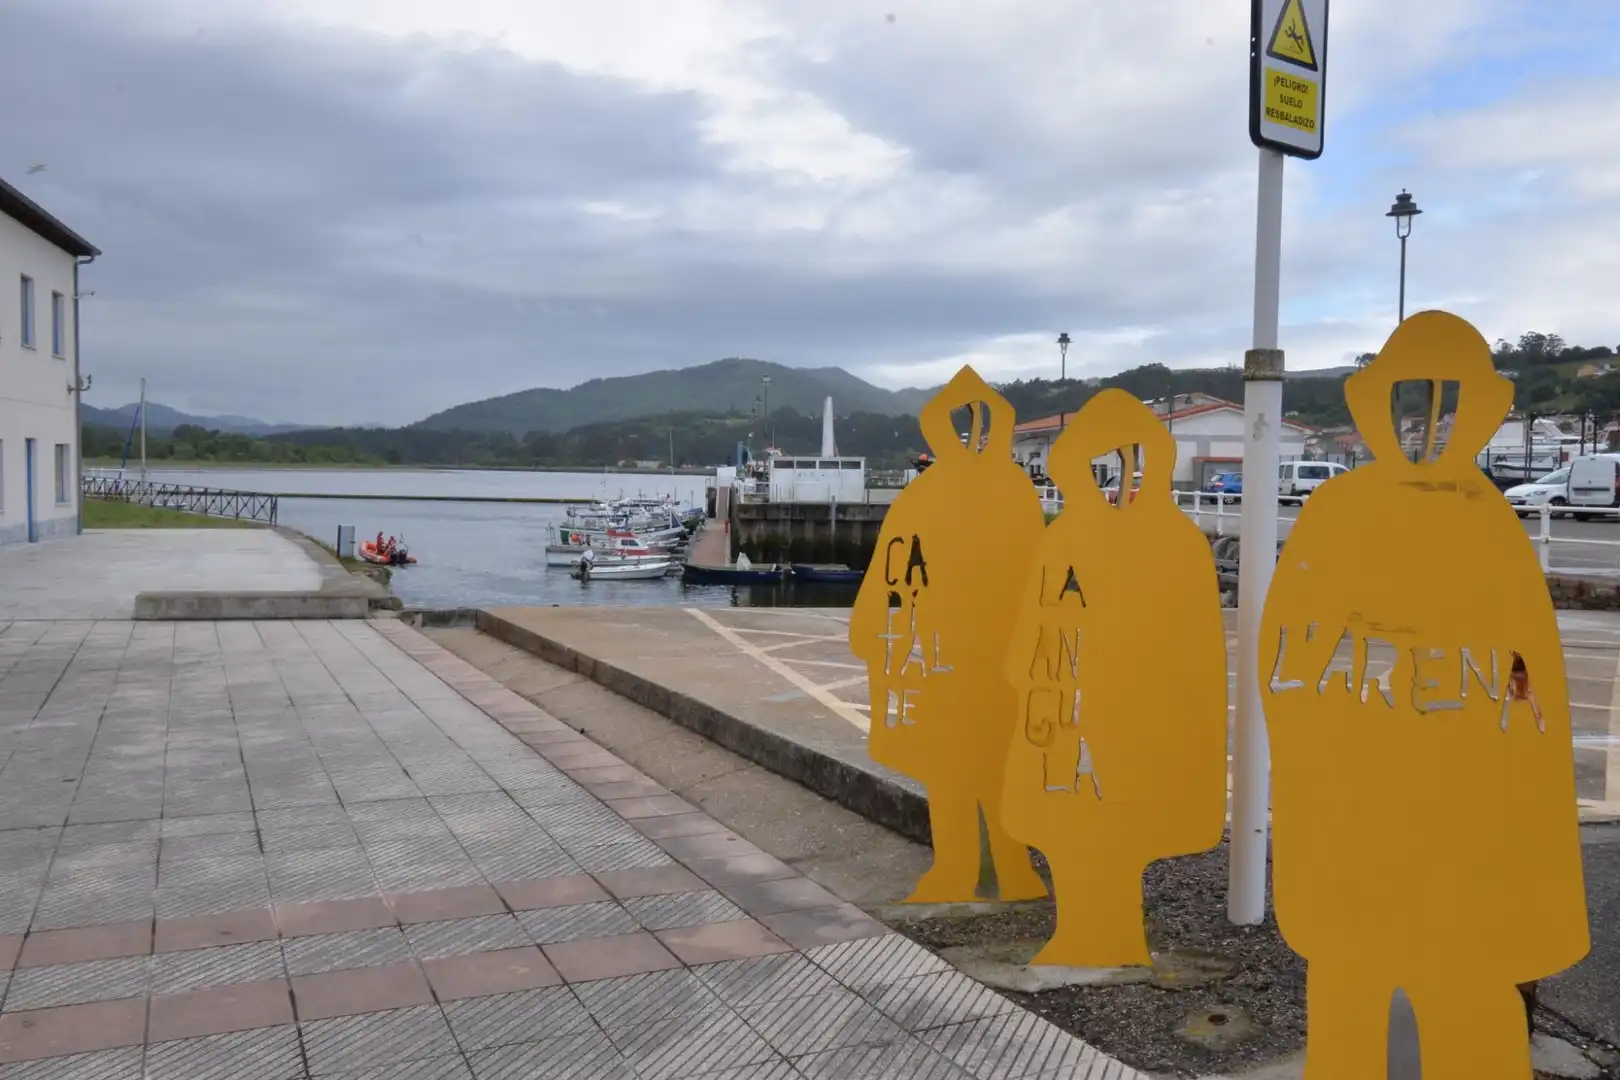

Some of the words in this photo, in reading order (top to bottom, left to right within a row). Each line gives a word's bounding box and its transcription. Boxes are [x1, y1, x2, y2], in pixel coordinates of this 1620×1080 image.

[1266, 107, 1315, 128] RESBALADIZO
[1280, 94, 1303, 108] SUELO
[885, 533, 928, 587] CA
[1039, 564, 1086, 608] LA
[877, 629, 953, 677] TAL
[1029, 624, 1080, 681] AN
[1268, 620, 1545, 734] L'ARENA
[885, 689, 921, 728] DE
[1025, 688, 1081, 747] GU
[1043, 736, 1102, 801] LA
